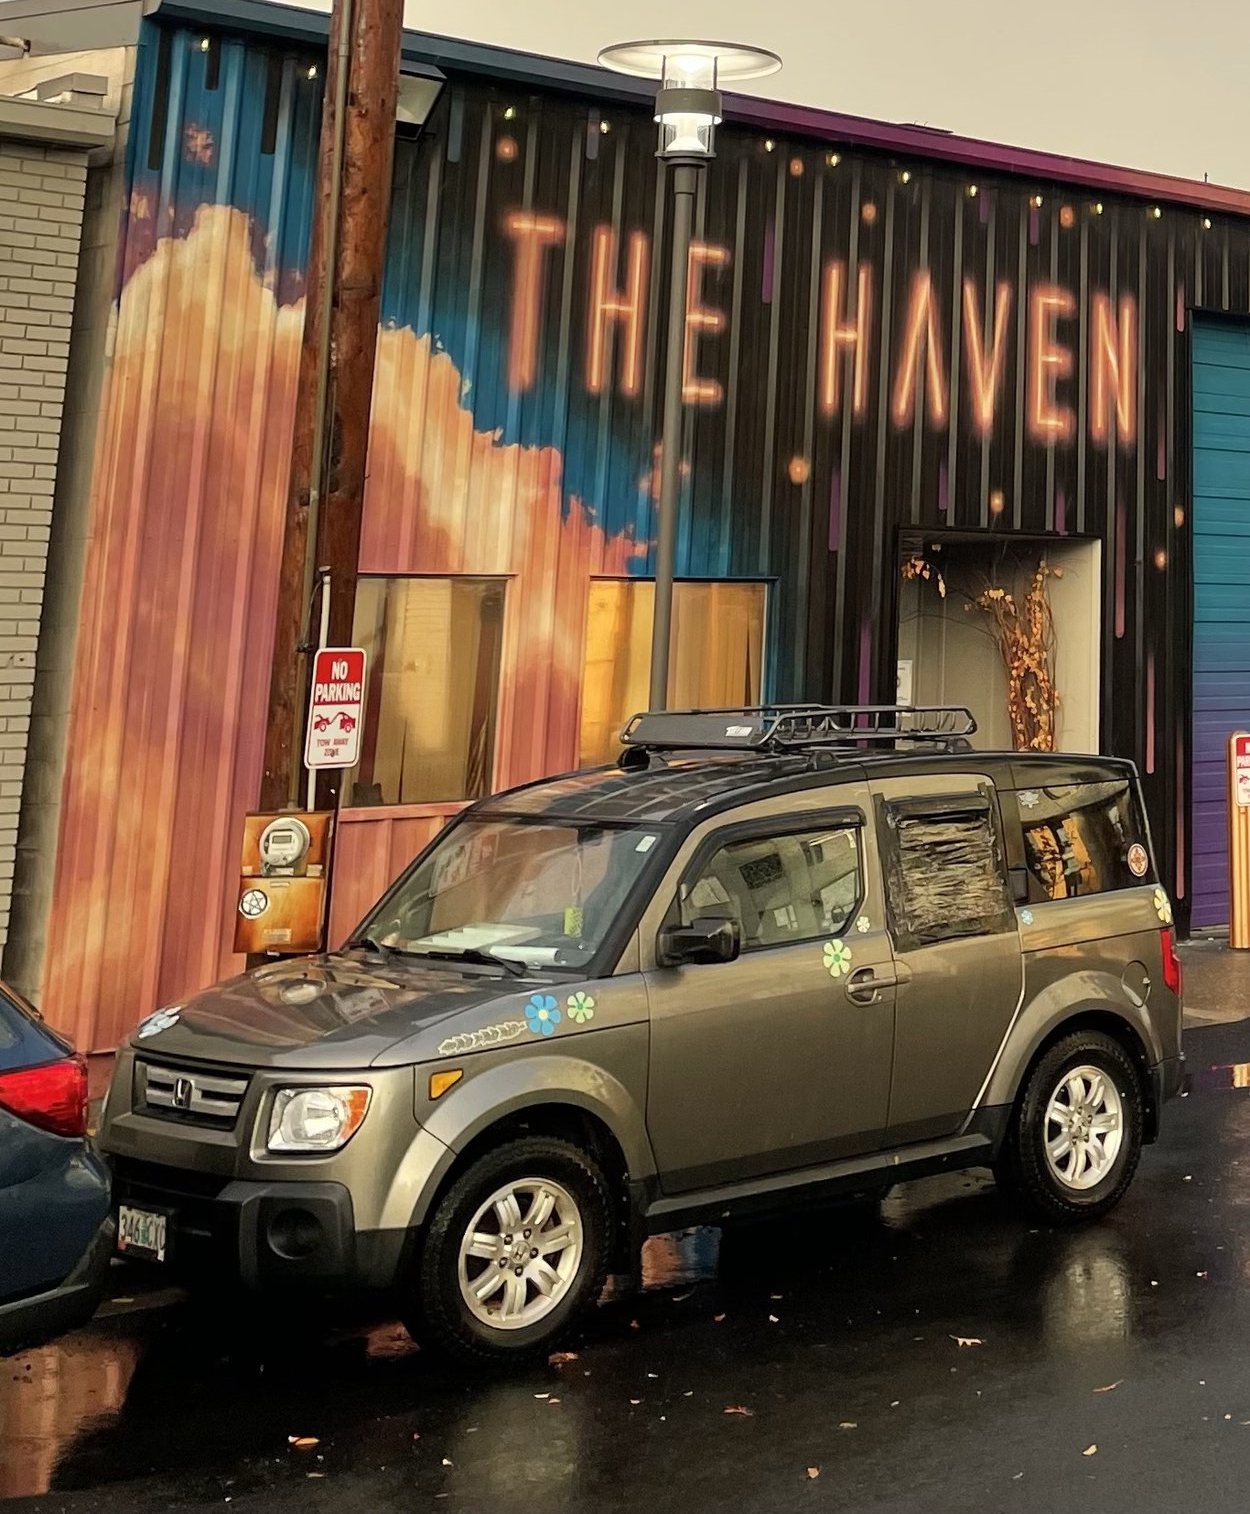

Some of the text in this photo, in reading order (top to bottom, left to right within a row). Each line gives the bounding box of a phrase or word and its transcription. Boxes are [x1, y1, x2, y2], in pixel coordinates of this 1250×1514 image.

[502, 208, 1139, 447] THE HAVEN
[331, 661, 348, 680] NO
[315, 682, 360, 702] PARKING
